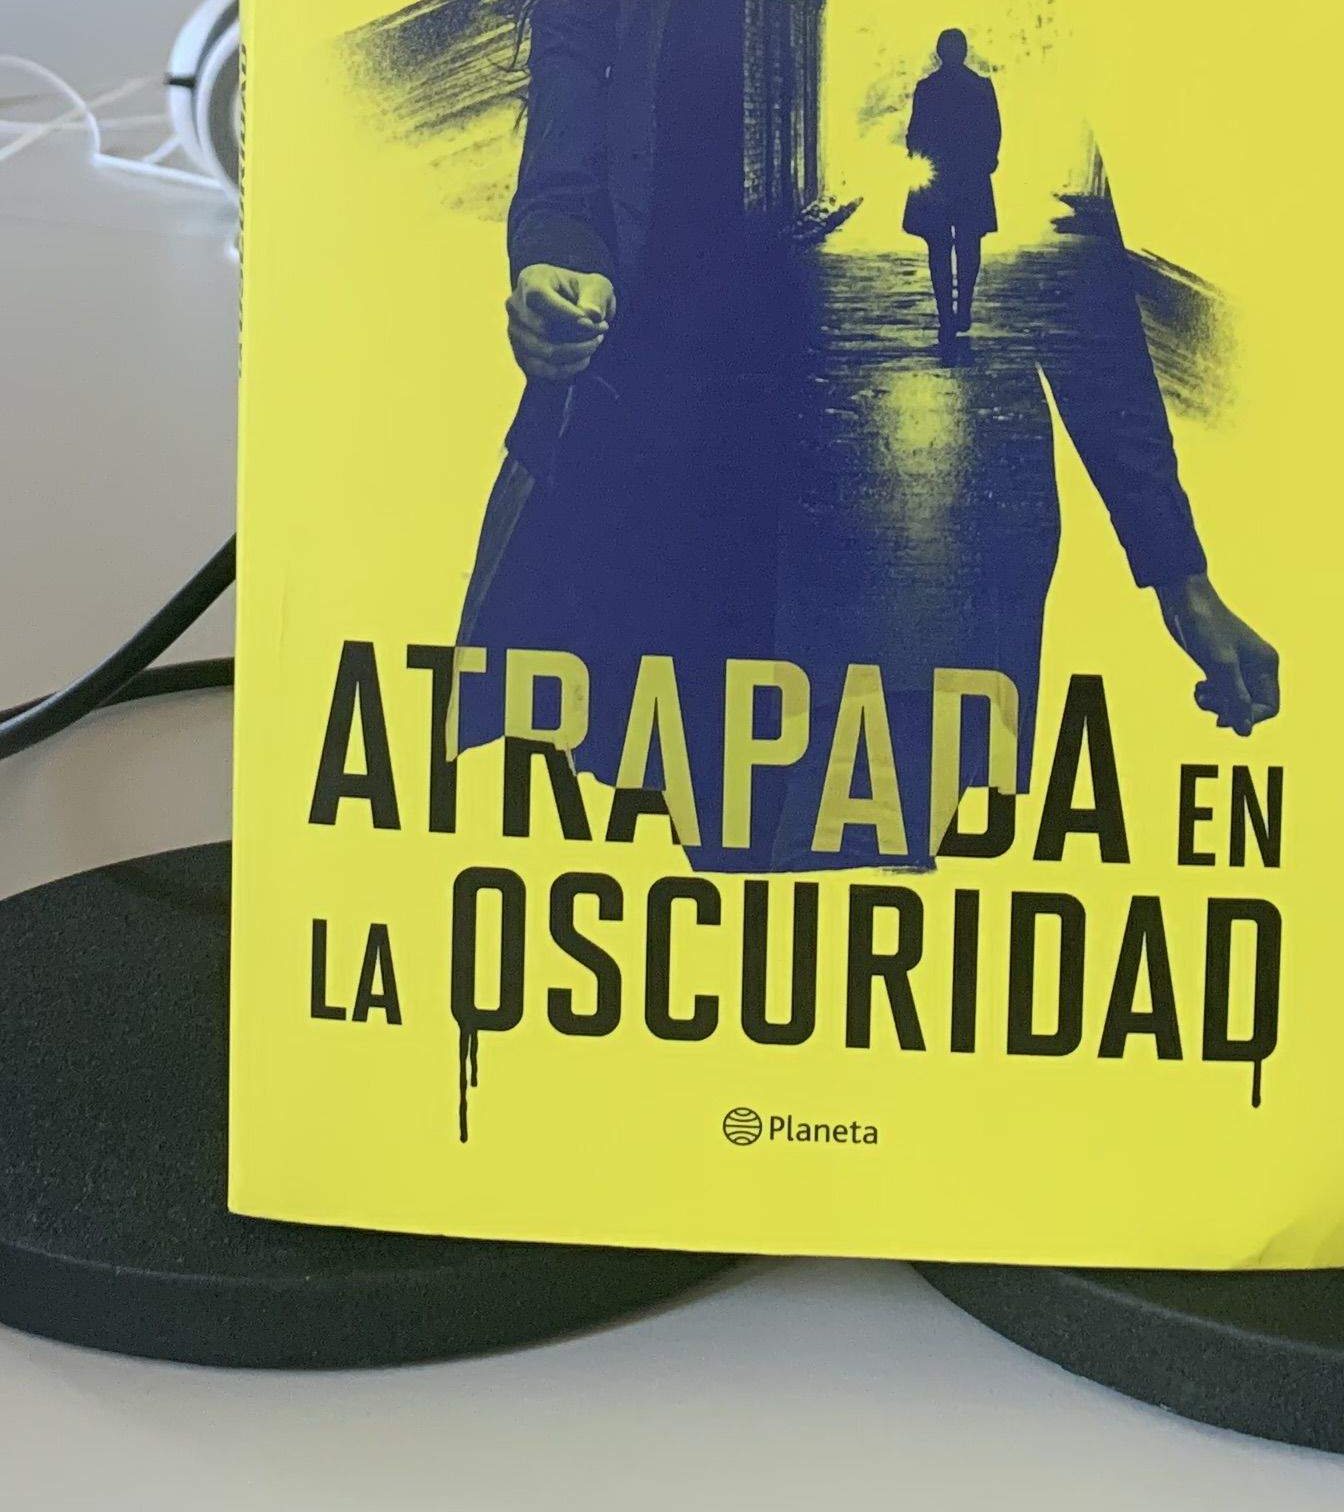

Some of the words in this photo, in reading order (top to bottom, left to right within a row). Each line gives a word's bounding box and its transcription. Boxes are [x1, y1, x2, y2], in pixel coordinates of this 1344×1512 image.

[308, 639, 1131, 865] ATRAPADA
[1177, 763, 1284, 869] EN
[310, 918, 403, 1026] LA
[449, 867, 1283, 1064] OSCURIDAD
[769, 1114, 878, 1144] Planeta
